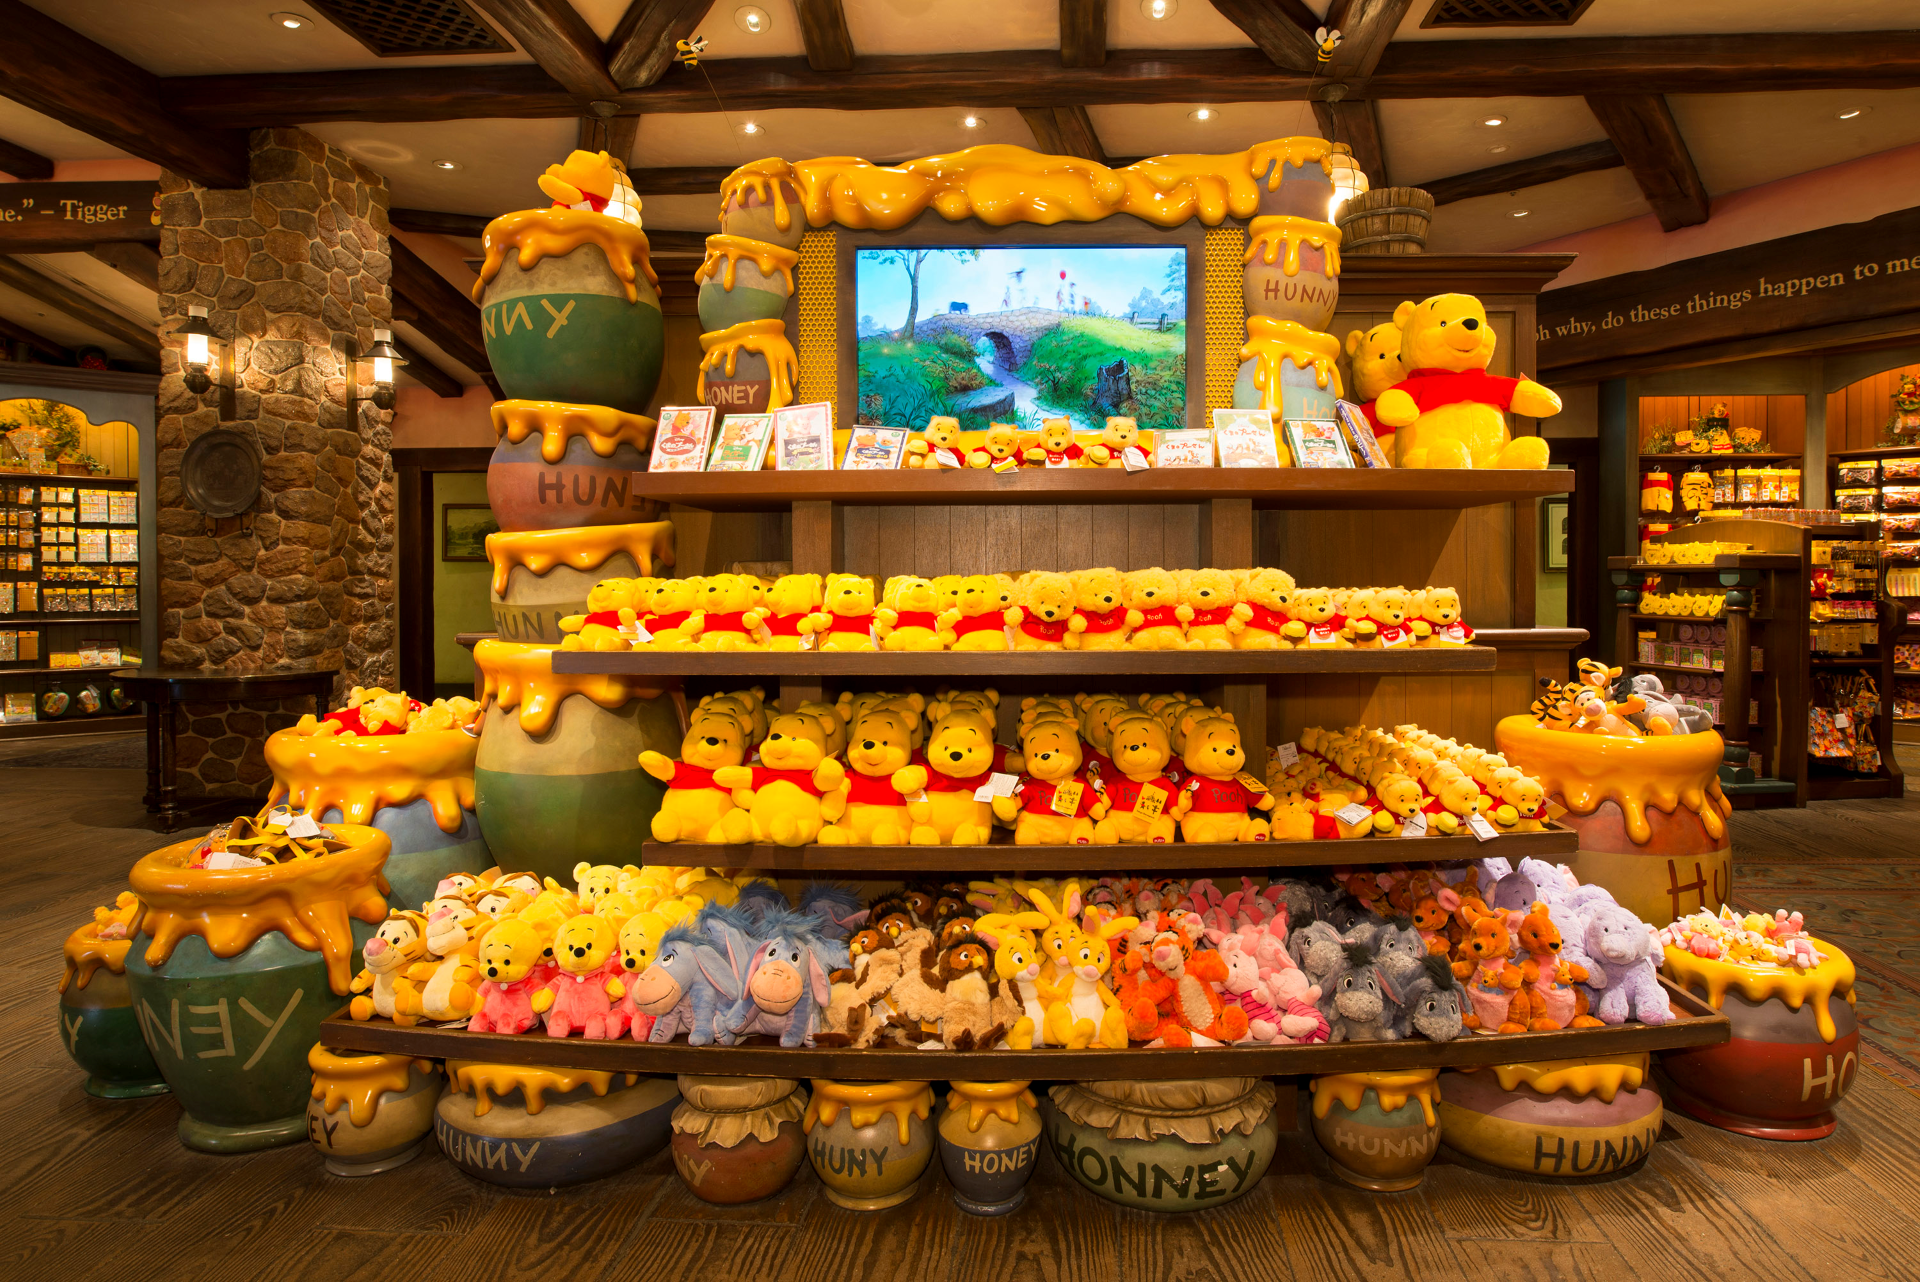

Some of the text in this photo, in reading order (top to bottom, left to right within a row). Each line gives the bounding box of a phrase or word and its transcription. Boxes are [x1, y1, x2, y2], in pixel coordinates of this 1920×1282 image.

[60, 200, 128, 224] Tigger
[1263, 279, 1337, 312] HUNNY
[1555, 317, 1596, 336] why,
[1602, 311, 1624, 330] do
[1629, 303, 1681, 323] these
[1686, 291, 1752, 314] things
[1758, 272, 1844, 297] happen
[1853, 264, 1879, 280] to
[705, 384, 760, 406] HONEY
[1165, 442, 1205, 450] くまのプーさん
[1223, 428, 1266, 437] くまのプーさん
[538, 471, 670, 512] HUN
[1038, 790, 1053, 806] Po
[1123, 787, 1138, 803] Po
[1211, 787, 1244, 805] Pooh
[1667, 859, 1731, 922] HU
[138, 988, 304, 1071] NEY
[1802, 1053, 1860, 1102] HO
[308, 1111, 340, 1150] EY
[437, 1119, 541, 1173] HUNNY
[1333, 1127, 1439, 1158] HUNNY
[813, 1137, 889, 1178] HUNY
[964, 1137, 1040, 1174] HONEY
[1056, 1122, 1255, 1200] HONNEY
